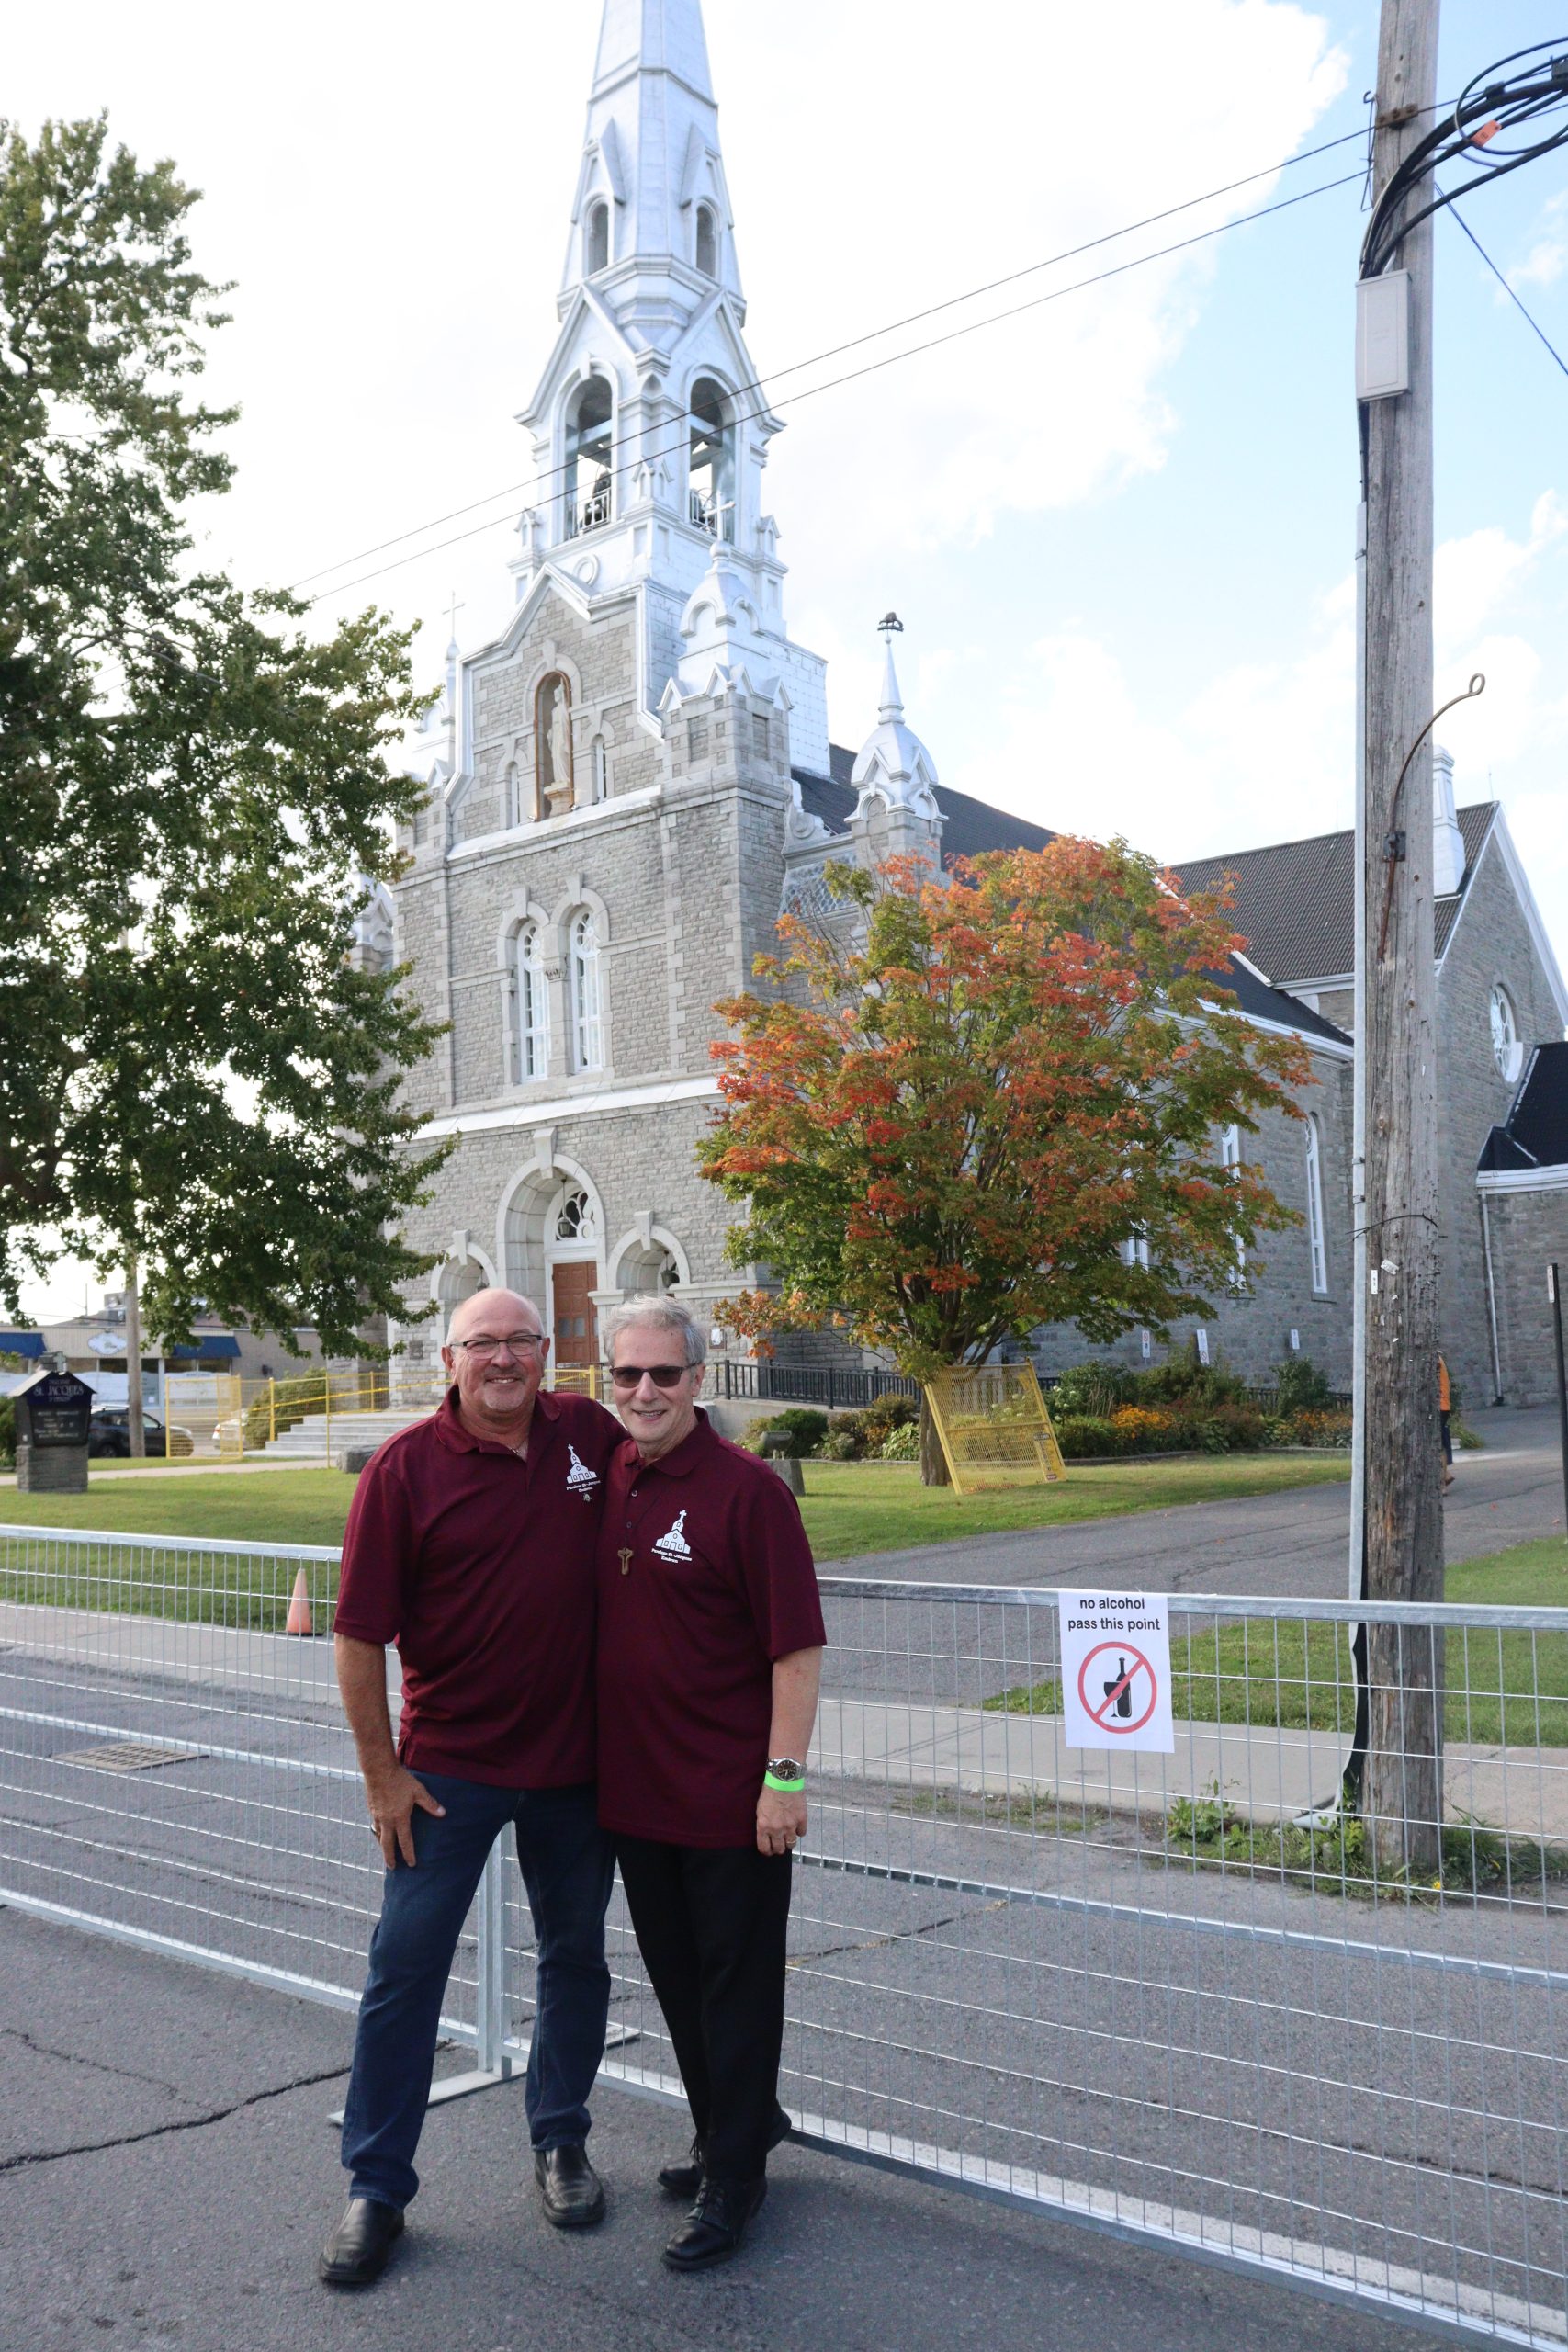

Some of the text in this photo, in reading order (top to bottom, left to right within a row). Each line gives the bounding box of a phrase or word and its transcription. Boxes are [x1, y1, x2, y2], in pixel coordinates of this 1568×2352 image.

[1079, 1597, 1145, 1609] no alcohol
[1067, 1618, 1161, 1633] pass this point
